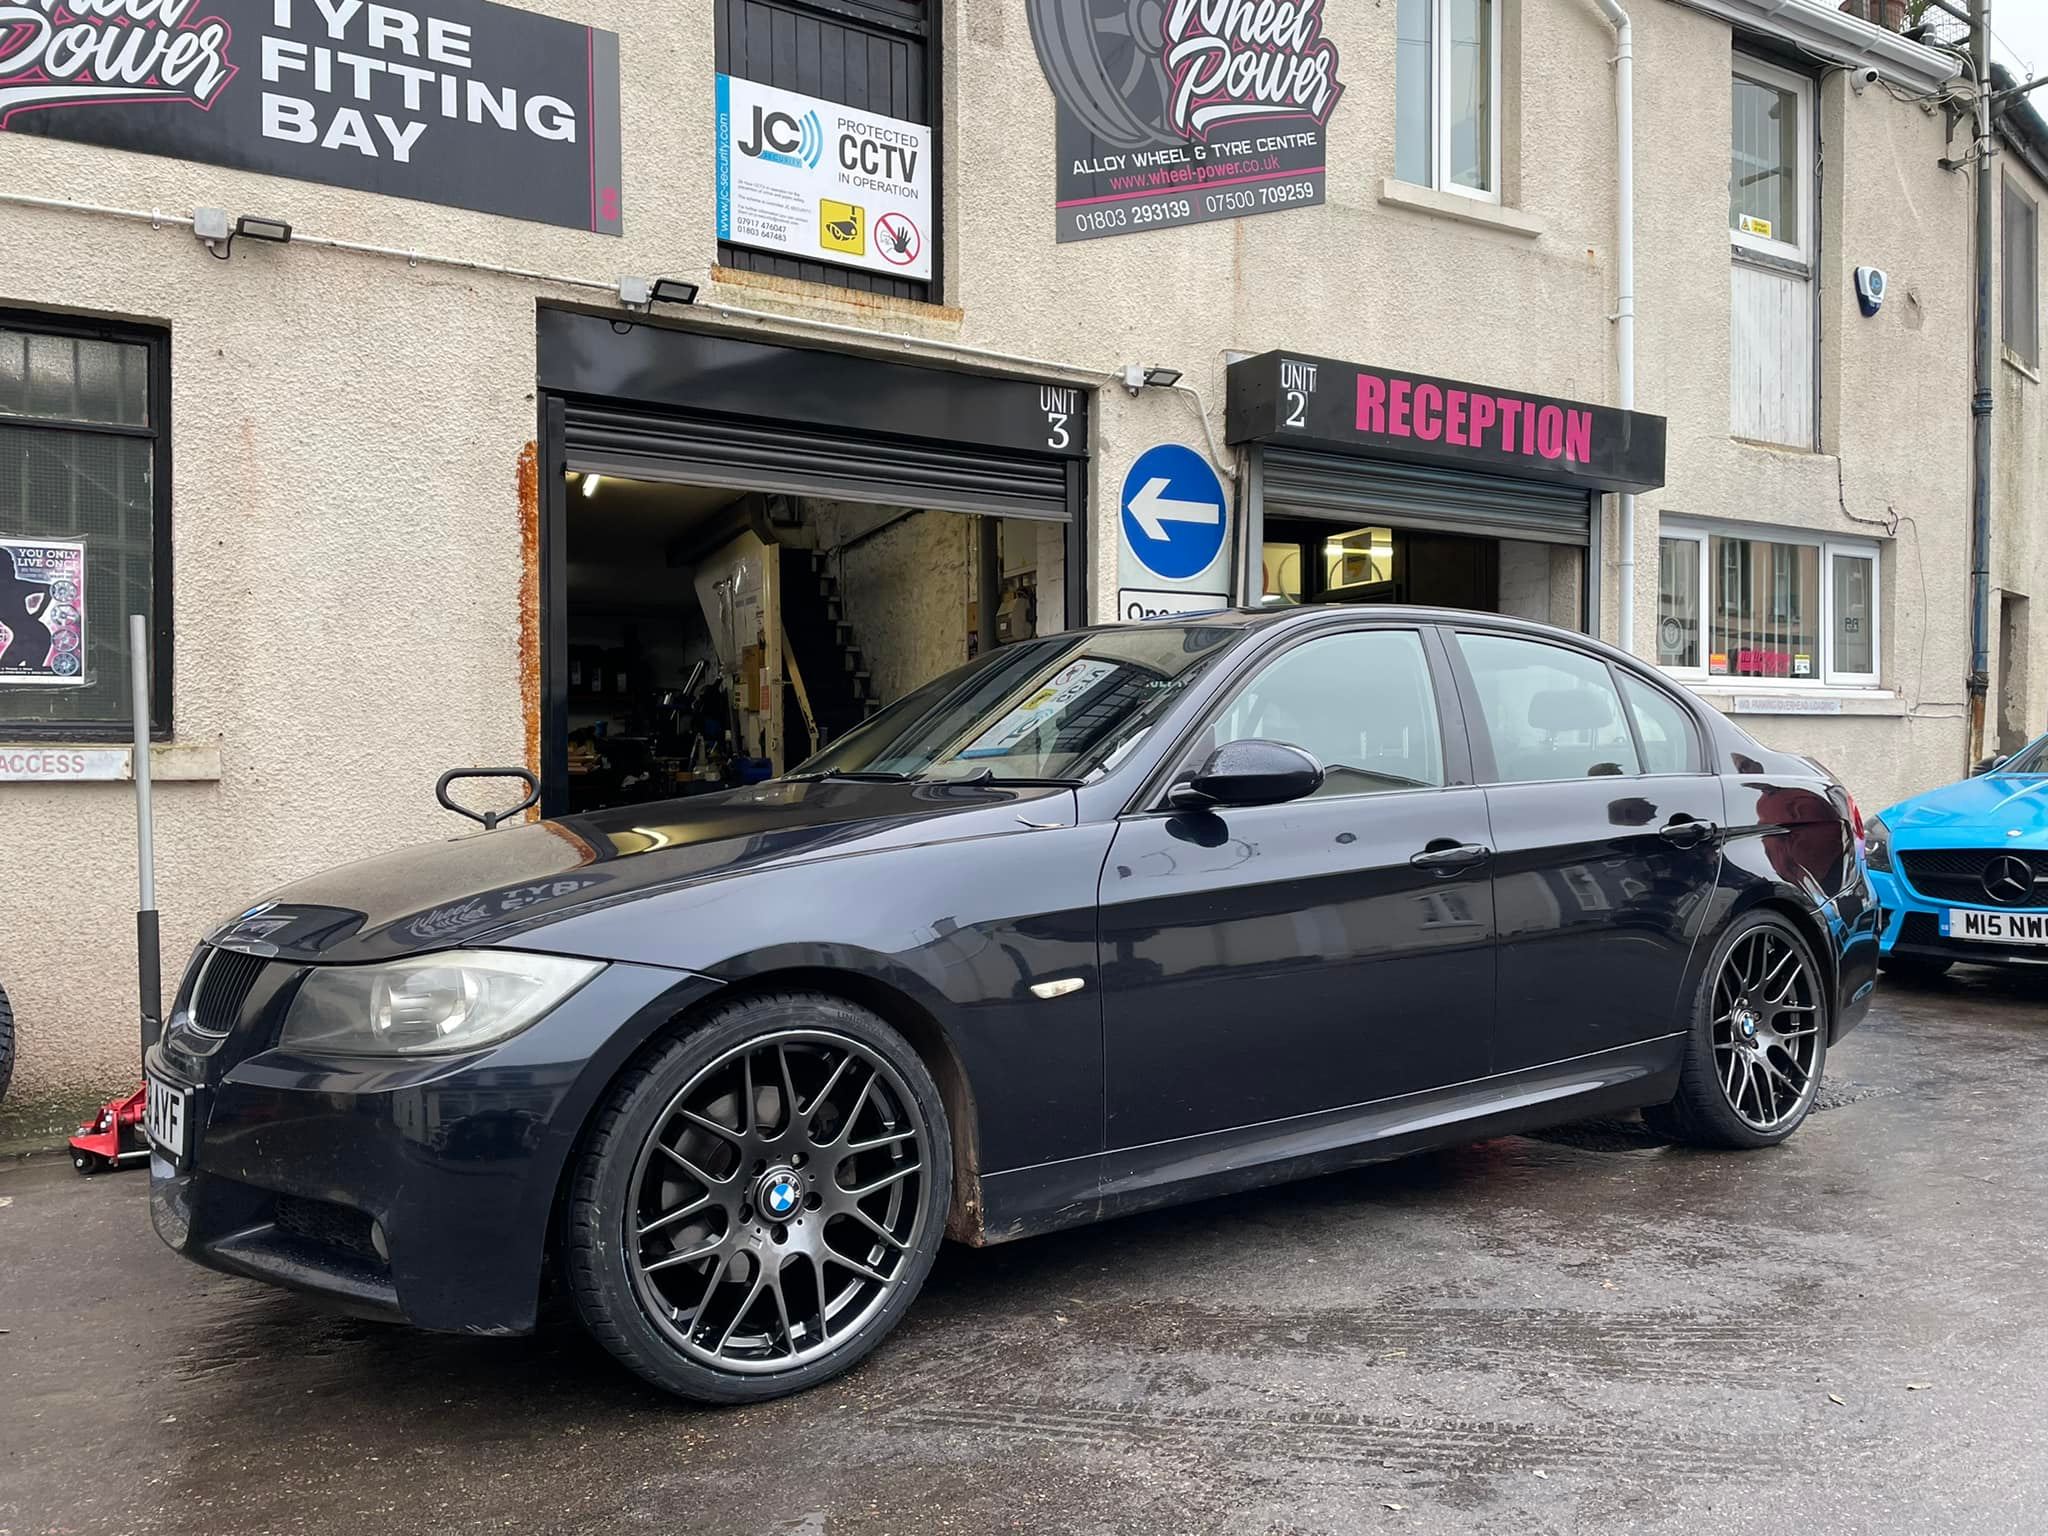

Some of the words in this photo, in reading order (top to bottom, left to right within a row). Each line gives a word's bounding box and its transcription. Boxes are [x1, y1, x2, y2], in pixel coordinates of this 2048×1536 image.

[1169, 0, 1313, 53] Wheel
[261, 35, 576, 143] FITTING
[1169, 37, 1331, 128] Power
[261, 91, 428, 163] BAY
[737, 105, 801, 157] JC
[838, 117, 918, 148] PROTECTED
[839, 134, 917, 183] CCTV
[1073, 155, 1126, 175] ALLOY
[1132, 148, 1190, 167] WHEEL
[1195, 146, 1206, 160] &
[1212, 140, 1253, 157] TYRE
[1257, 132, 1317, 152] CENTRE
[719, 112, 730, 232] www.jc-security.com
[838, 172, 850, 185] IN
[853, 175, 919, 200] OPERATION
[1110, 154, 1280, 190] www.wheel-power.co.uk
[1206, 190, 1256, 214] 07500
[1259, 181, 1314, 205] 709259
[737, 216, 759, 228] 07917
[1076, 208, 1127, 232] 01803
[1132, 200, 1190, 224] 293139
[1281, 363, 1316, 392] UNIT
[1041, 385, 1078, 415] UNIT
[1285, 391, 1306, 427] 2
[1355, 373, 1593, 463] RECEPTION
[1048, 412, 1069, 448] 3
[17, 558, 43, 567] LIVE
[45, 559, 79, 569] ONCE
[19, 548, 43, 558] YOU
[46, 550, 78, 559] ONLY
[0, 754, 85, 774] ACCESS
[2009, 916, 2048, 938] NW
[154, 1083, 180, 1144] AYF
